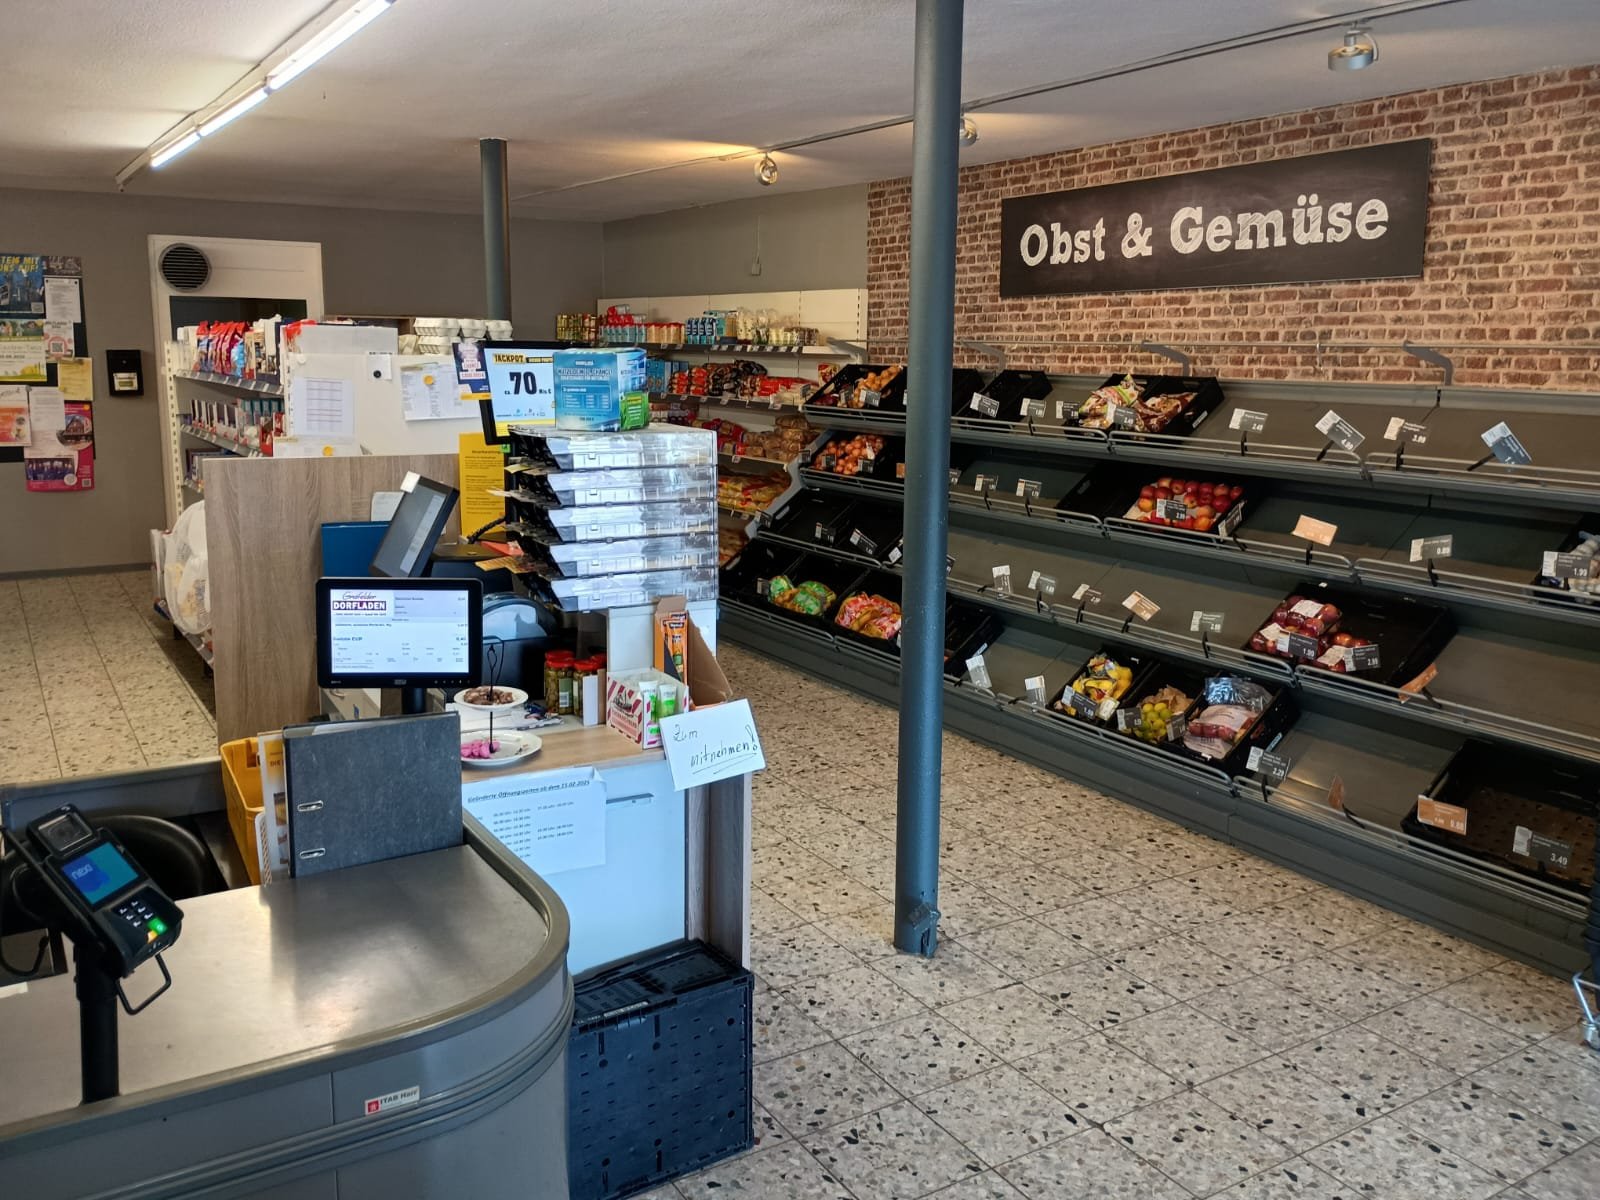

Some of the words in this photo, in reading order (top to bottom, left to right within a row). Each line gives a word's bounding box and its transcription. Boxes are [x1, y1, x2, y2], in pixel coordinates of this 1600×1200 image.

[1020, 217, 1106, 267] Obst
[1120, 212, 1153, 259] &
[1170, 194, 1389, 255] Gemüse
[495, 354, 524, 363] JACKPOT
[509, 371, 537, 395] 70
[333, 602, 385, 610] DORFLADEN
[673, 723, 698, 742] Zum
[1550, 853, 1568, 865] 3.49
[71, 864, 93, 880] nexi
